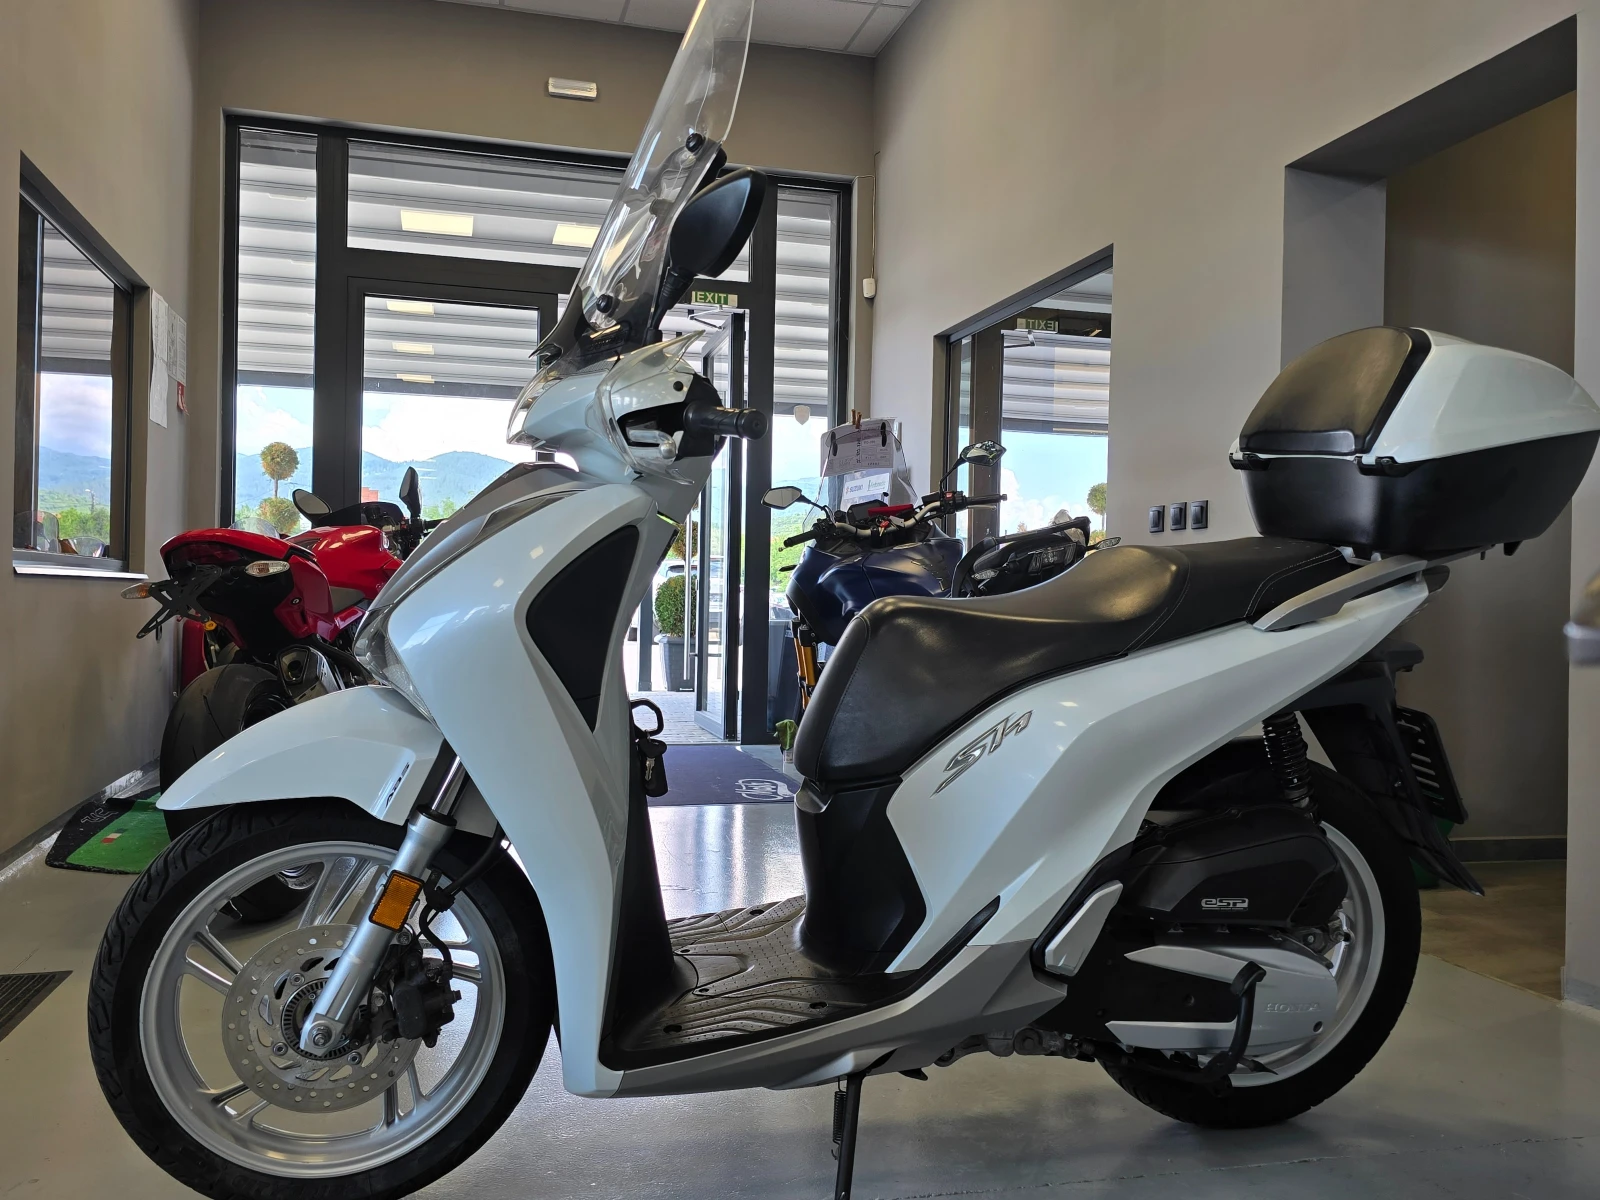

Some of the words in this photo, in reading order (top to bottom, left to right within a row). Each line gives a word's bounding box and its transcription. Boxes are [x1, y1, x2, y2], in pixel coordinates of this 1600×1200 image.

[697, 291, 727, 304] EXIT
[930, 709, 1033, 799] SH
[1265, 1002, 1321, 1013] HONDA
